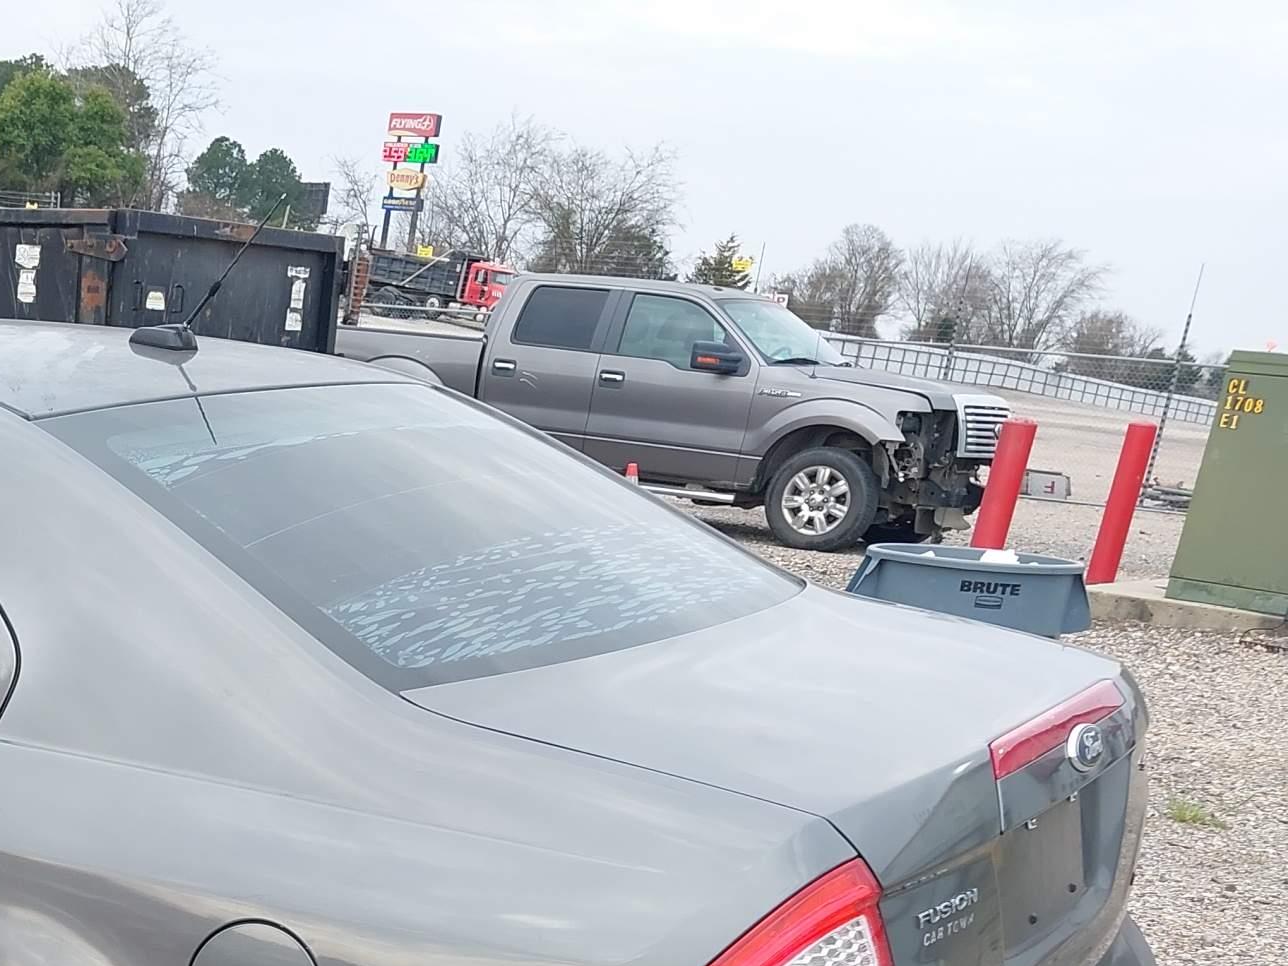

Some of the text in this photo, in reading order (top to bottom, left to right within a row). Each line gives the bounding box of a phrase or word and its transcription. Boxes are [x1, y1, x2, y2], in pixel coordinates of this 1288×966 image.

[1228, 379, 1247, 395] CL
[1223, 396, 1264, 414] 1708
[959, 579, 1022, 596] BRUTE
[917, 887, 979, 929] FUSION
